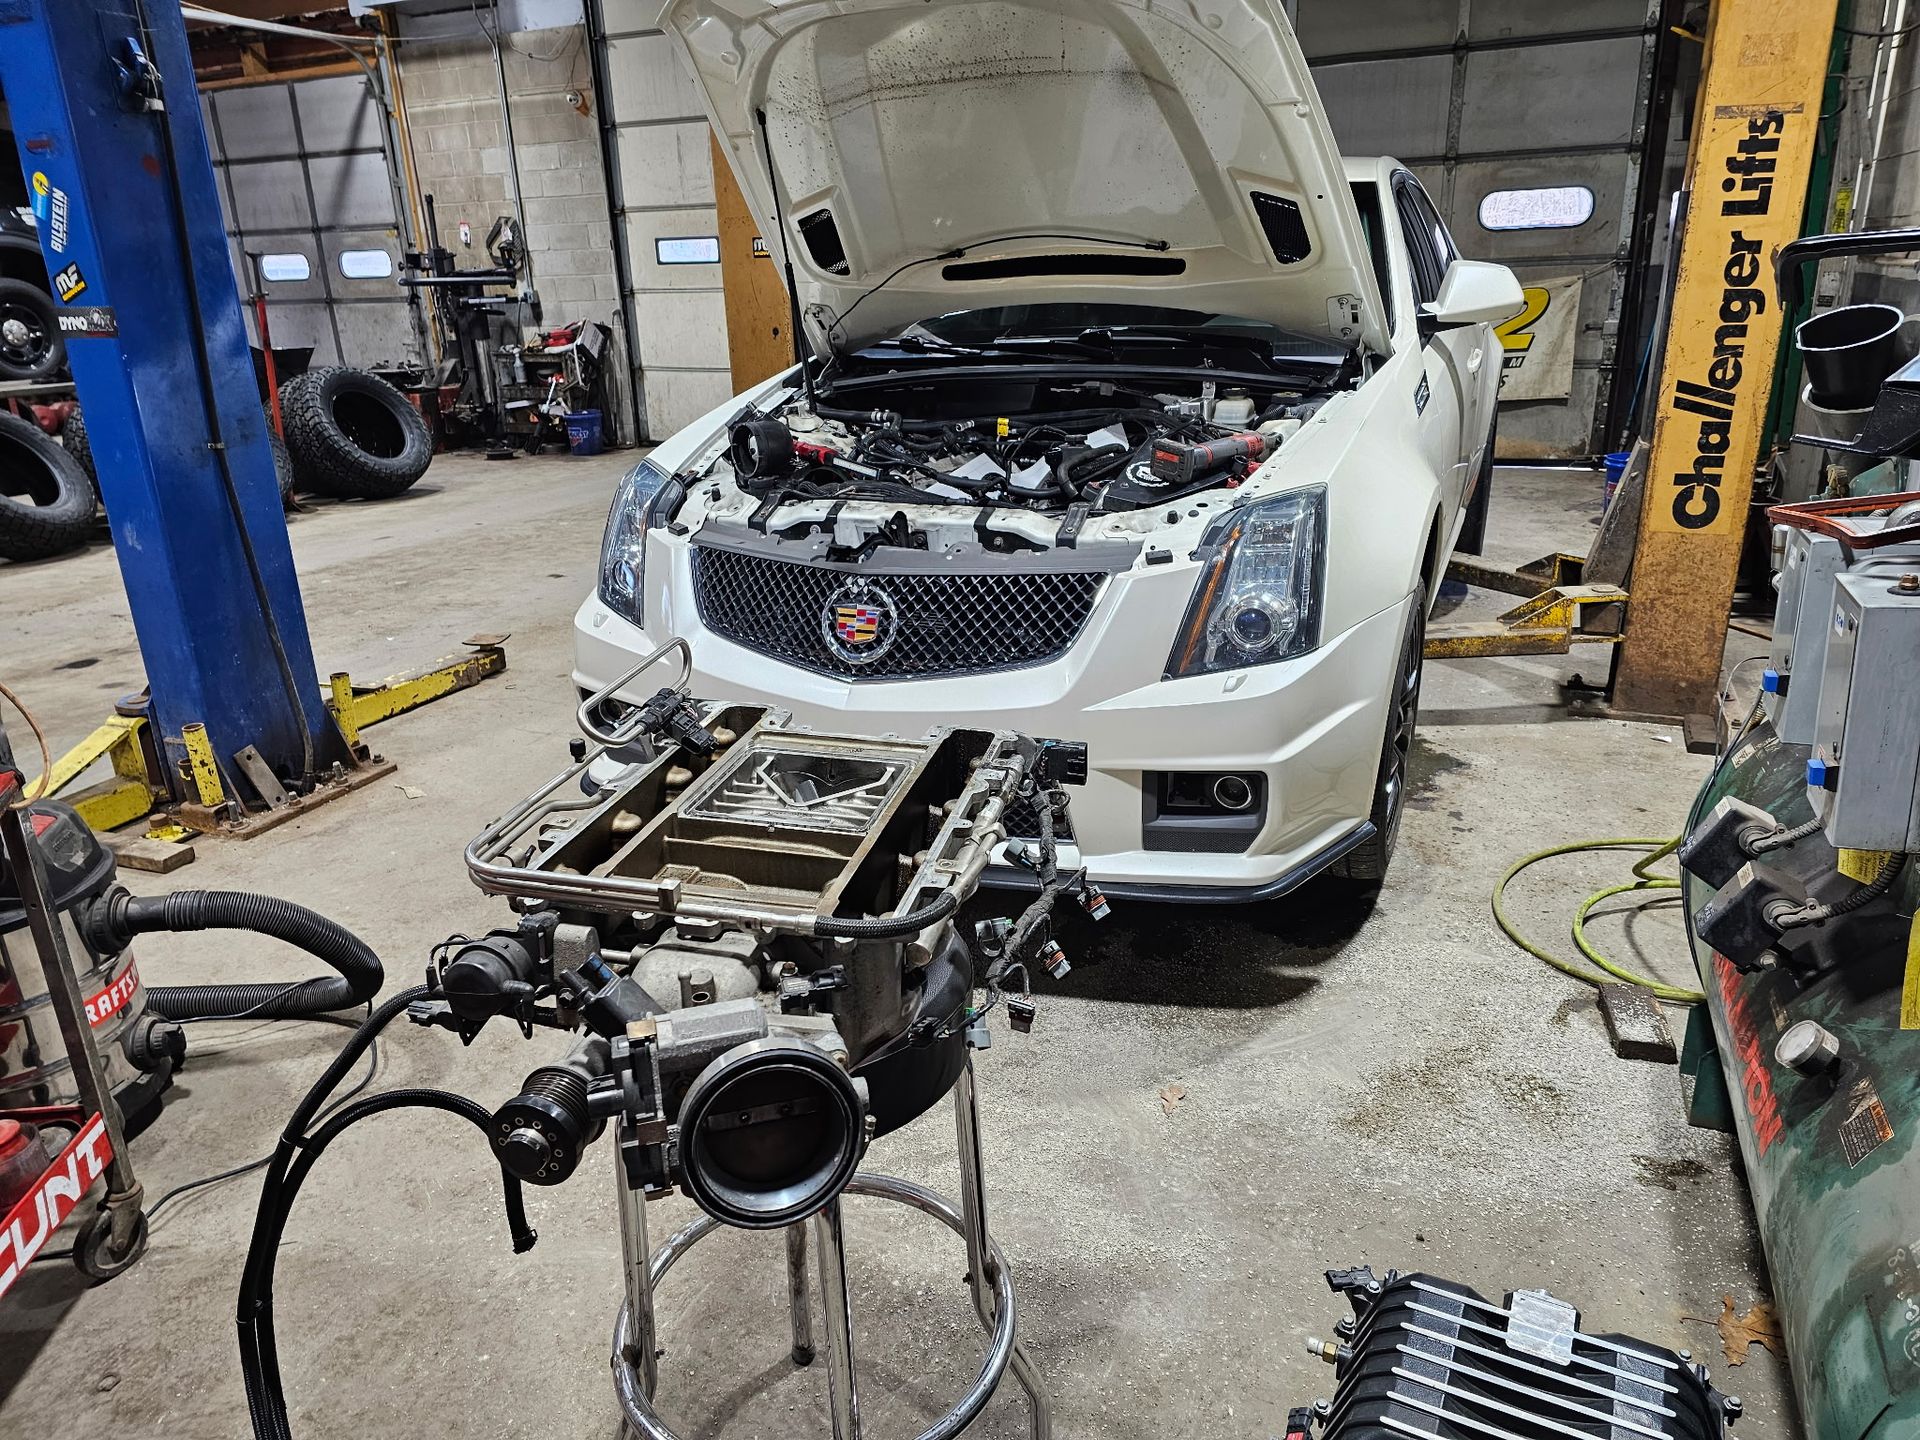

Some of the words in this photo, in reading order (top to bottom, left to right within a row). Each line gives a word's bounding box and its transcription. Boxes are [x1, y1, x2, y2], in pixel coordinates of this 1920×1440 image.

[50, 187, 66, 253] BILSTEIN
[1672, 230, 1765, 529] Challenger
[1720, 110, 1784, 216] Lifts
